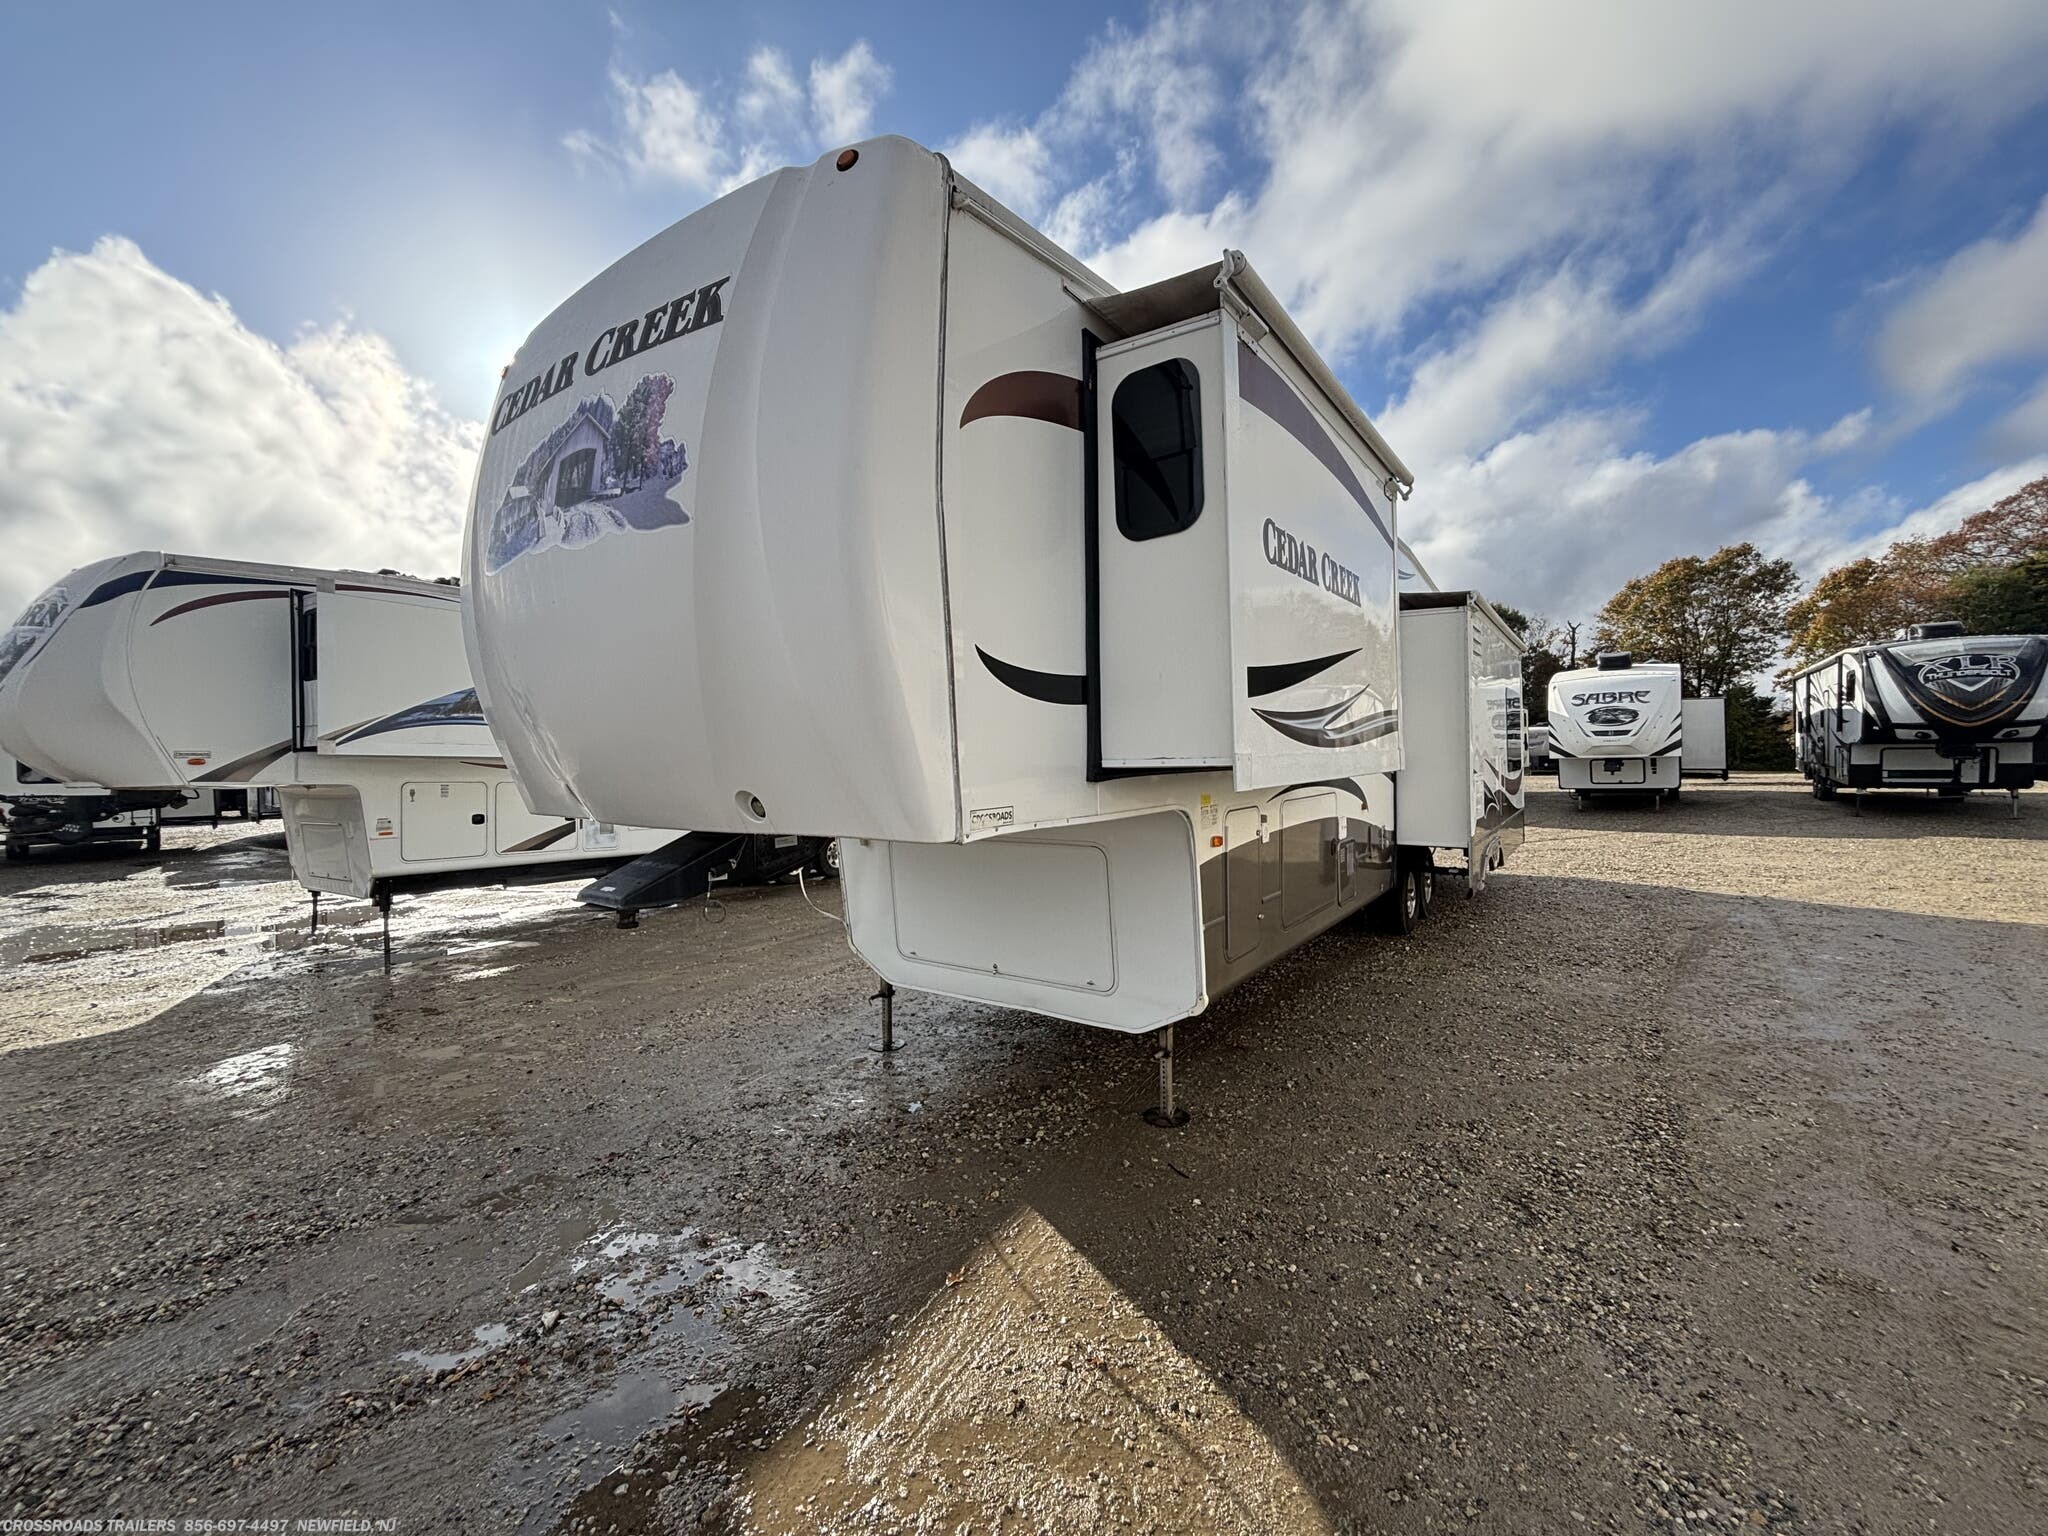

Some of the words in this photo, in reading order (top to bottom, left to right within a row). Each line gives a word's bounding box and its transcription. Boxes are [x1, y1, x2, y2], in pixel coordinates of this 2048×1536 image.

[492, 351, 579, 436] CEDAR
[584, 276, 731, 377] CREEK
[1262, 517, 1319, 586] CEDAR
[1321, 552, 1362, 608] CREEK
[1914, 655, 2020, 680] XLR
[1926, 669, 2012, 680] THUNDERBOLT
[1571, 690, 1651, 707] SABRE
